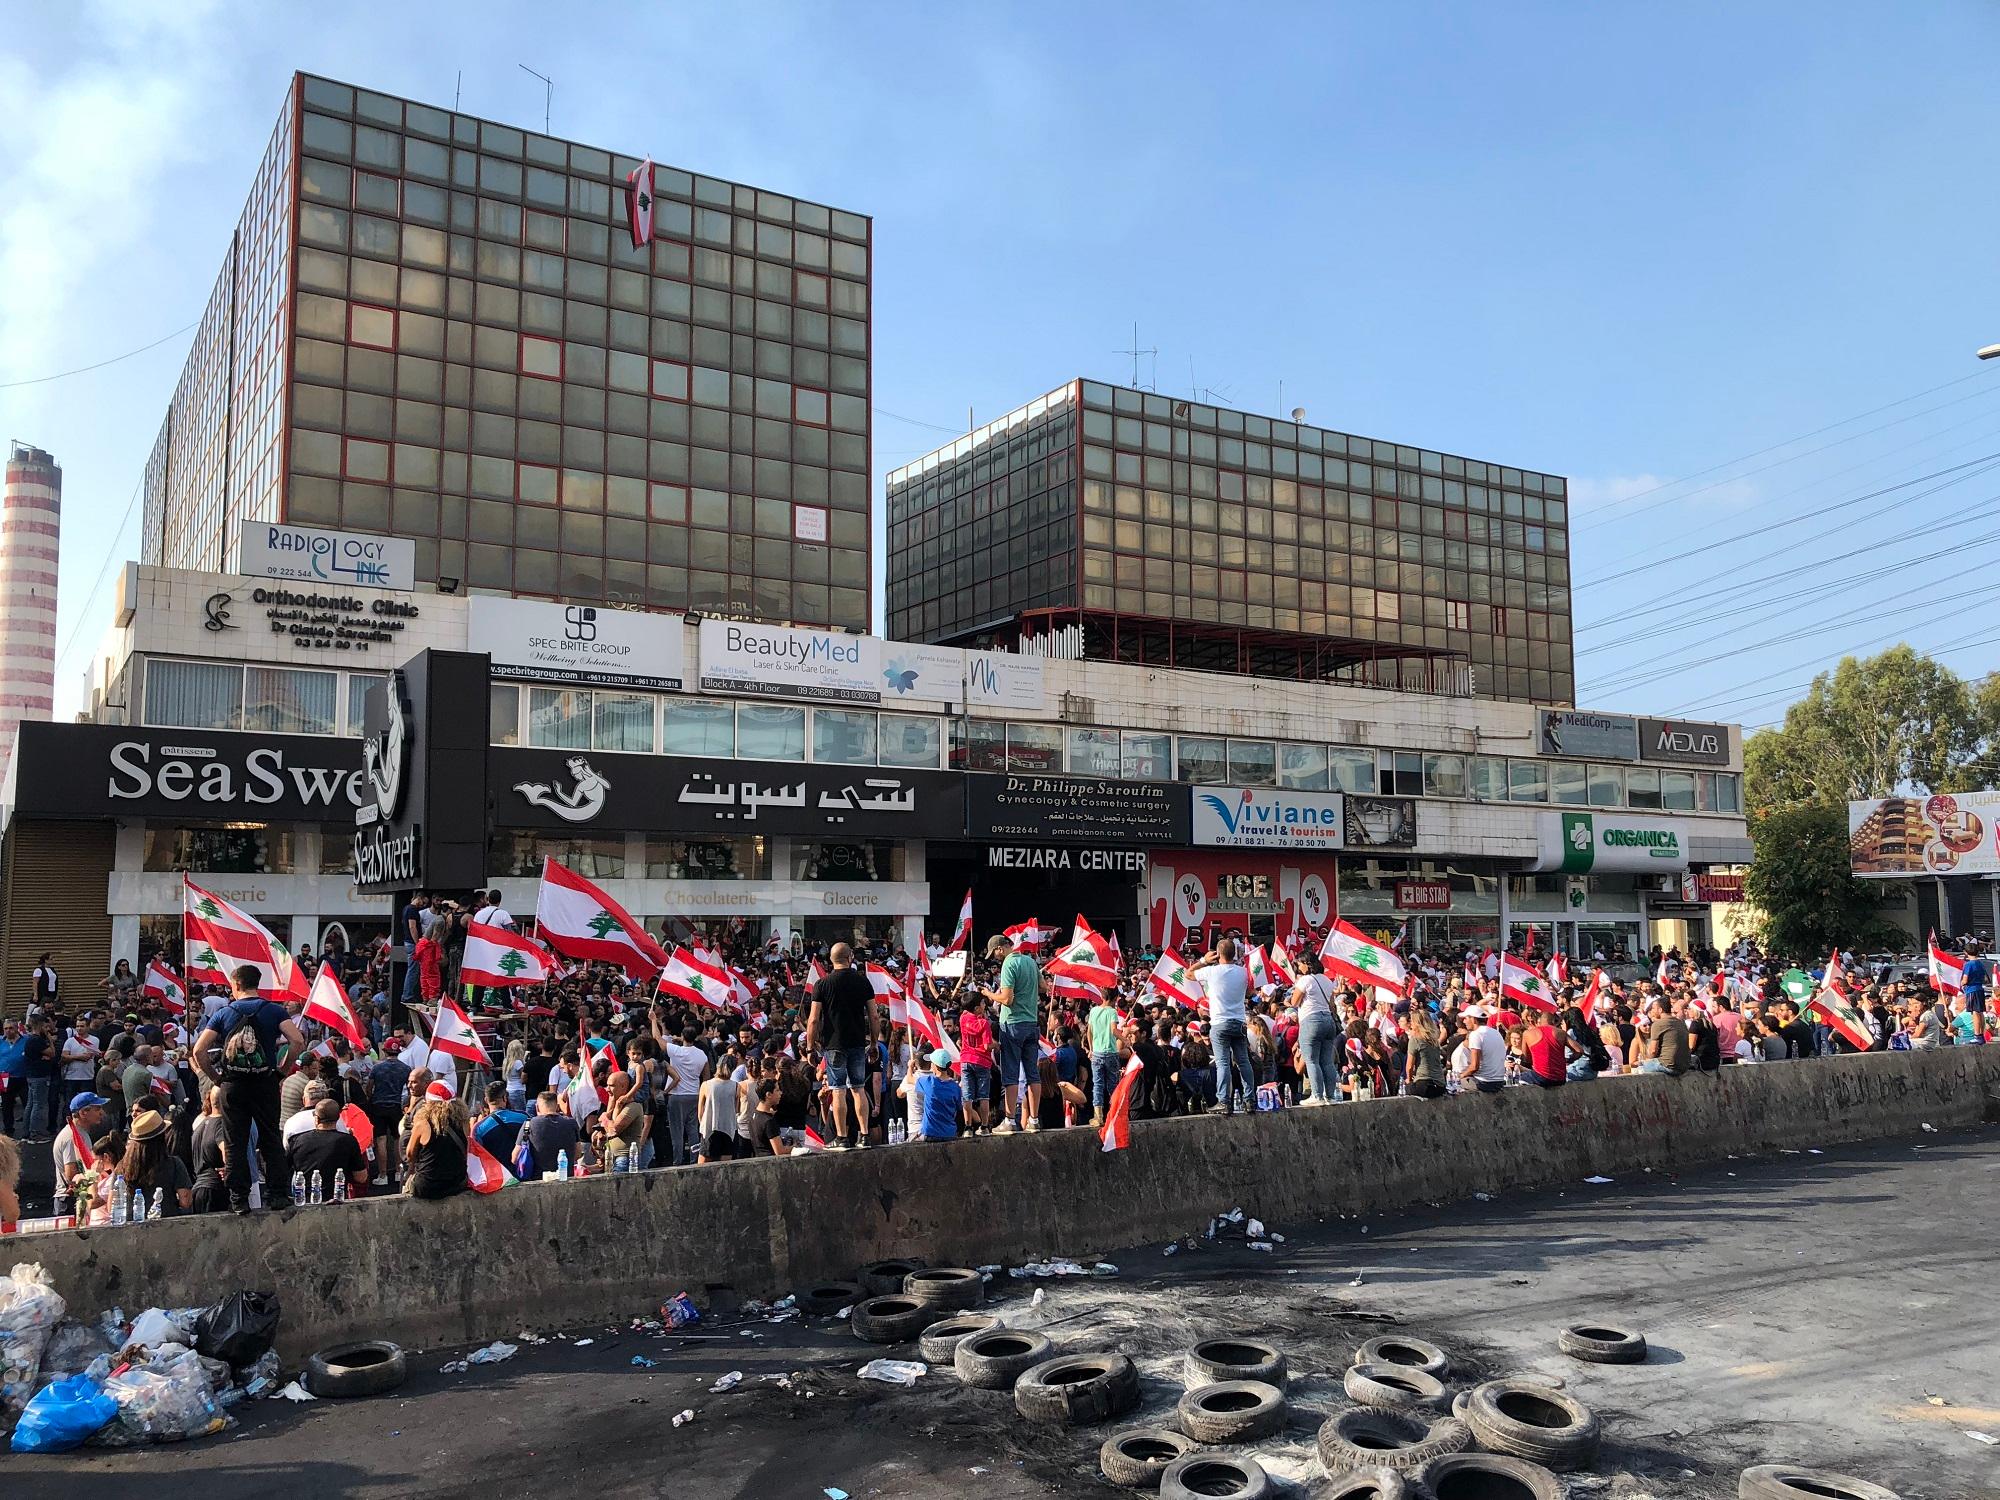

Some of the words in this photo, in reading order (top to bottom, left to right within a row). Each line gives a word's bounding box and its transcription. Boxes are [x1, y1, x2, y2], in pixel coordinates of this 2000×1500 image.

[268, 527, 385, 561] RADIOLOGY
[267, 566, 277, 574] 09
[280, 567, 295, 576] 222
[297, 568, 312, 577] 544
[252, 588, 364, 612] Orthodontic
[372, 599, 420, 618] Clinic
[271, 621, 287, 633] Dr
[289, 624, 334, 638] Claude
[336, 627, 393, 642] Saroufim
[295, 638, 311, 648] 03
[529, 637, 557, 649] SPEC
[560, 640, 589, 652] BRITE
[591, 643, 631, 655] GROUP
[727, 627, 859, 664] BeautyMed
[529, 651, 577, 666] Wellbeing
[754, 658, 775, 671] Laser
[776, 661, 782, 670] &
[783, 662, 800, 672] Skin
[801, 663, 818, 674] Care
[819, 665, 839, 676] Clinic
[586, 673, 600, 682] +961
[635, 677, 649, 686] +961
[704, 679, 728, 689] Block
[729, 680, 736, 689] A
[743, 683, 758, 691] 4th
[759, 683, 781, 693] Floor
[797, 686, 807, 696] 09
[840, 689, 850, 698] 03
[1566, 713, 1611, 731] MediCorp
[1657, 731, 1719, 754] MEDLAB
[678, 773, 806, 820] سويت
[1006, 778, 1028, 792] Dr.
[1032, 779, 1094, 797] Philippe
[1097, 782, 1164, 797] Saroufim
[818, 785, 915, 823] سي
[997, 794, 1067, 807] Gynecology
[1070, 797, 1078, 806] &
[1080, 798, 1129, 808] Cosmetic
[1132, 802, 1170, 811] surgery
[1198, 790, 1335, 834] Viviane
[991, 825, 1039, 834] 09/222644
[1052, 828, 1125, 837] pmclebanon.com
[1240, 824, 1278, 836] travel
[1280, 825, 1288, 836] &
[1290, 825, 1336, 837] tourism
[1603, 828, 1679, 848] ORGANICA
[1215, 836, 1225, 844] 09
[1233, 837, 1243, 845] 21
[1245, 837, 1255, 846] 88
[1256, 838, 1265, 846] 21
[1294, 839, 1304, 847] 30
[1306, 839, 1315, 847] 50
[1316, 839, 1326, 847] 70
[989, 847, 1071, 870] MEZIARA
[1080, 850, 1147, 871] CENTER
[173, 885, 267, 903] Psserie
[1226, 874, 1268, 898] ICE
[1415, 887, 1428, 903] BIG
[1429, 887, 1448, 903] STAR
[664, 889, 757, 905] Chocolaterie
[823, 890, 879, 906] Glacerie
[1700, 889, 1745, 902] DONUTS
[1208, 901, 1286, 911] COLLECTION
